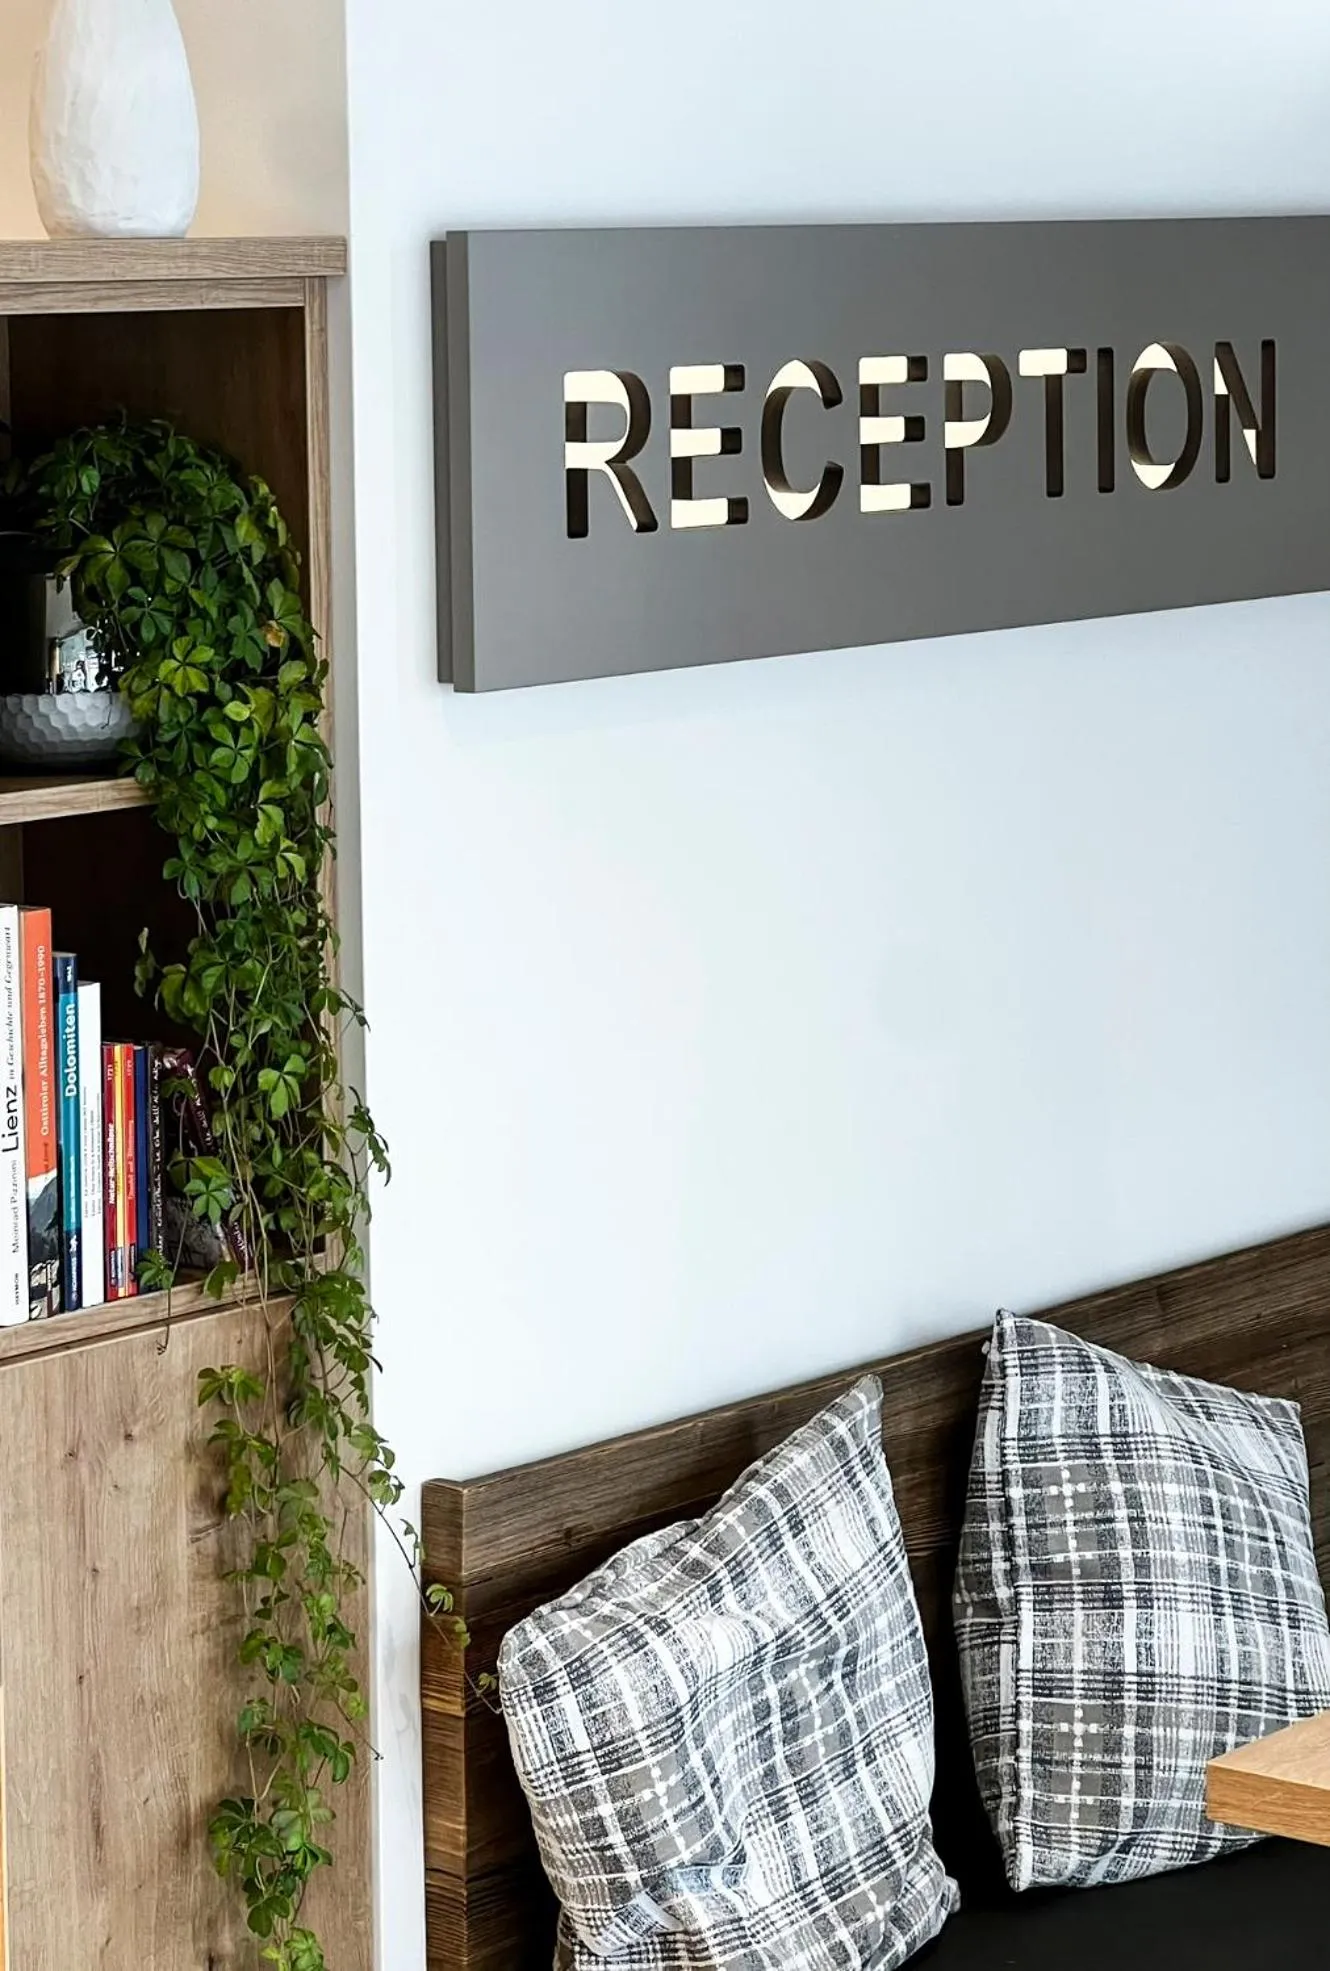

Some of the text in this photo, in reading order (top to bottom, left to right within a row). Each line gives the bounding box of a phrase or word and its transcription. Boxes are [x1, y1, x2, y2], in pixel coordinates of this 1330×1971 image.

[563, 338, 1276, 539] RECEPTION
[3, 926, 13, 984] Gegenwart
[4, 985, 13, 1008] und
[5, 1010, 15, 1066] Geschichte
[38, 1006, 49, 1077] Alltagsleben
[62, 1002, 78, 1097] Dolomiten
[1, 1084, 19, 1153] Lienz
[39, 1081, 50, 1136] Osttiroler
